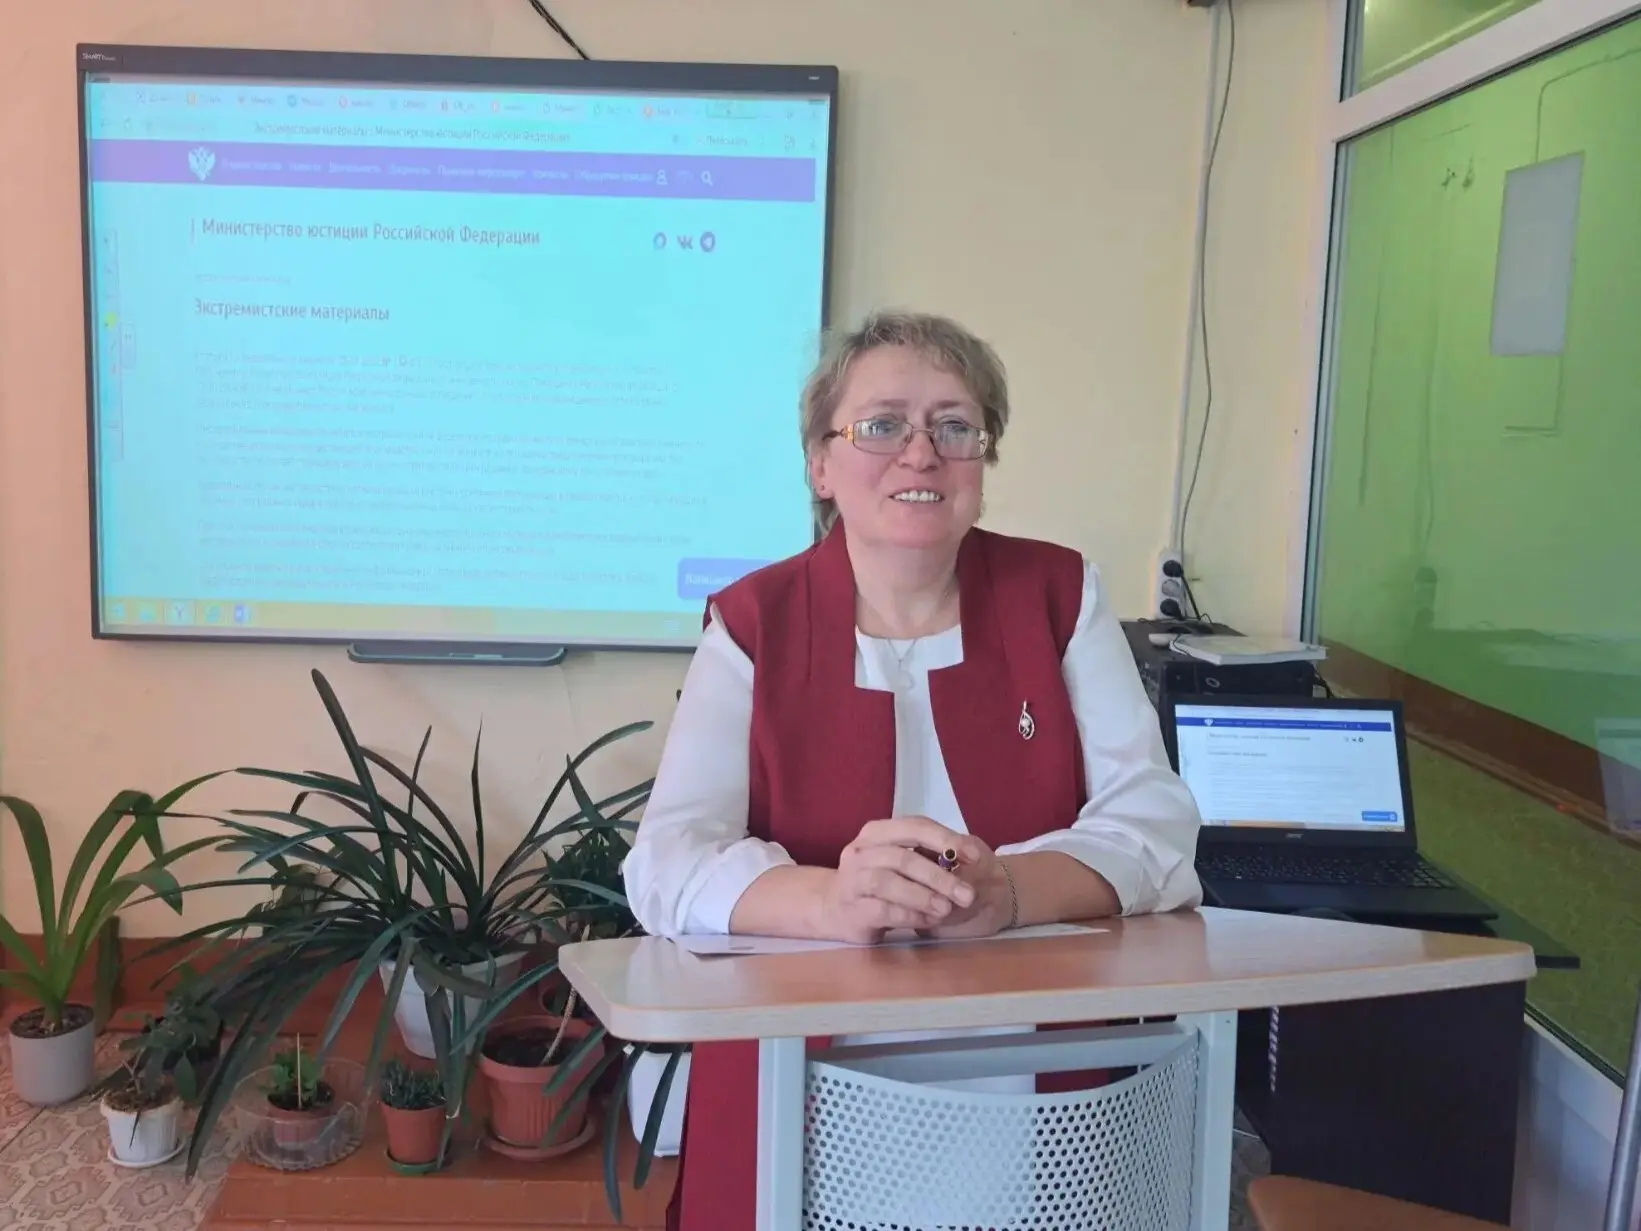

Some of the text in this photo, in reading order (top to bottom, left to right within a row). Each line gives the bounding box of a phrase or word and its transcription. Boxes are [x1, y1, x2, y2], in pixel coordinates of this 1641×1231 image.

[202, 218, 541, 248] Министерство юстиции Российской Федерации
[194, 298, 390, 324] Экстремистские материалы
